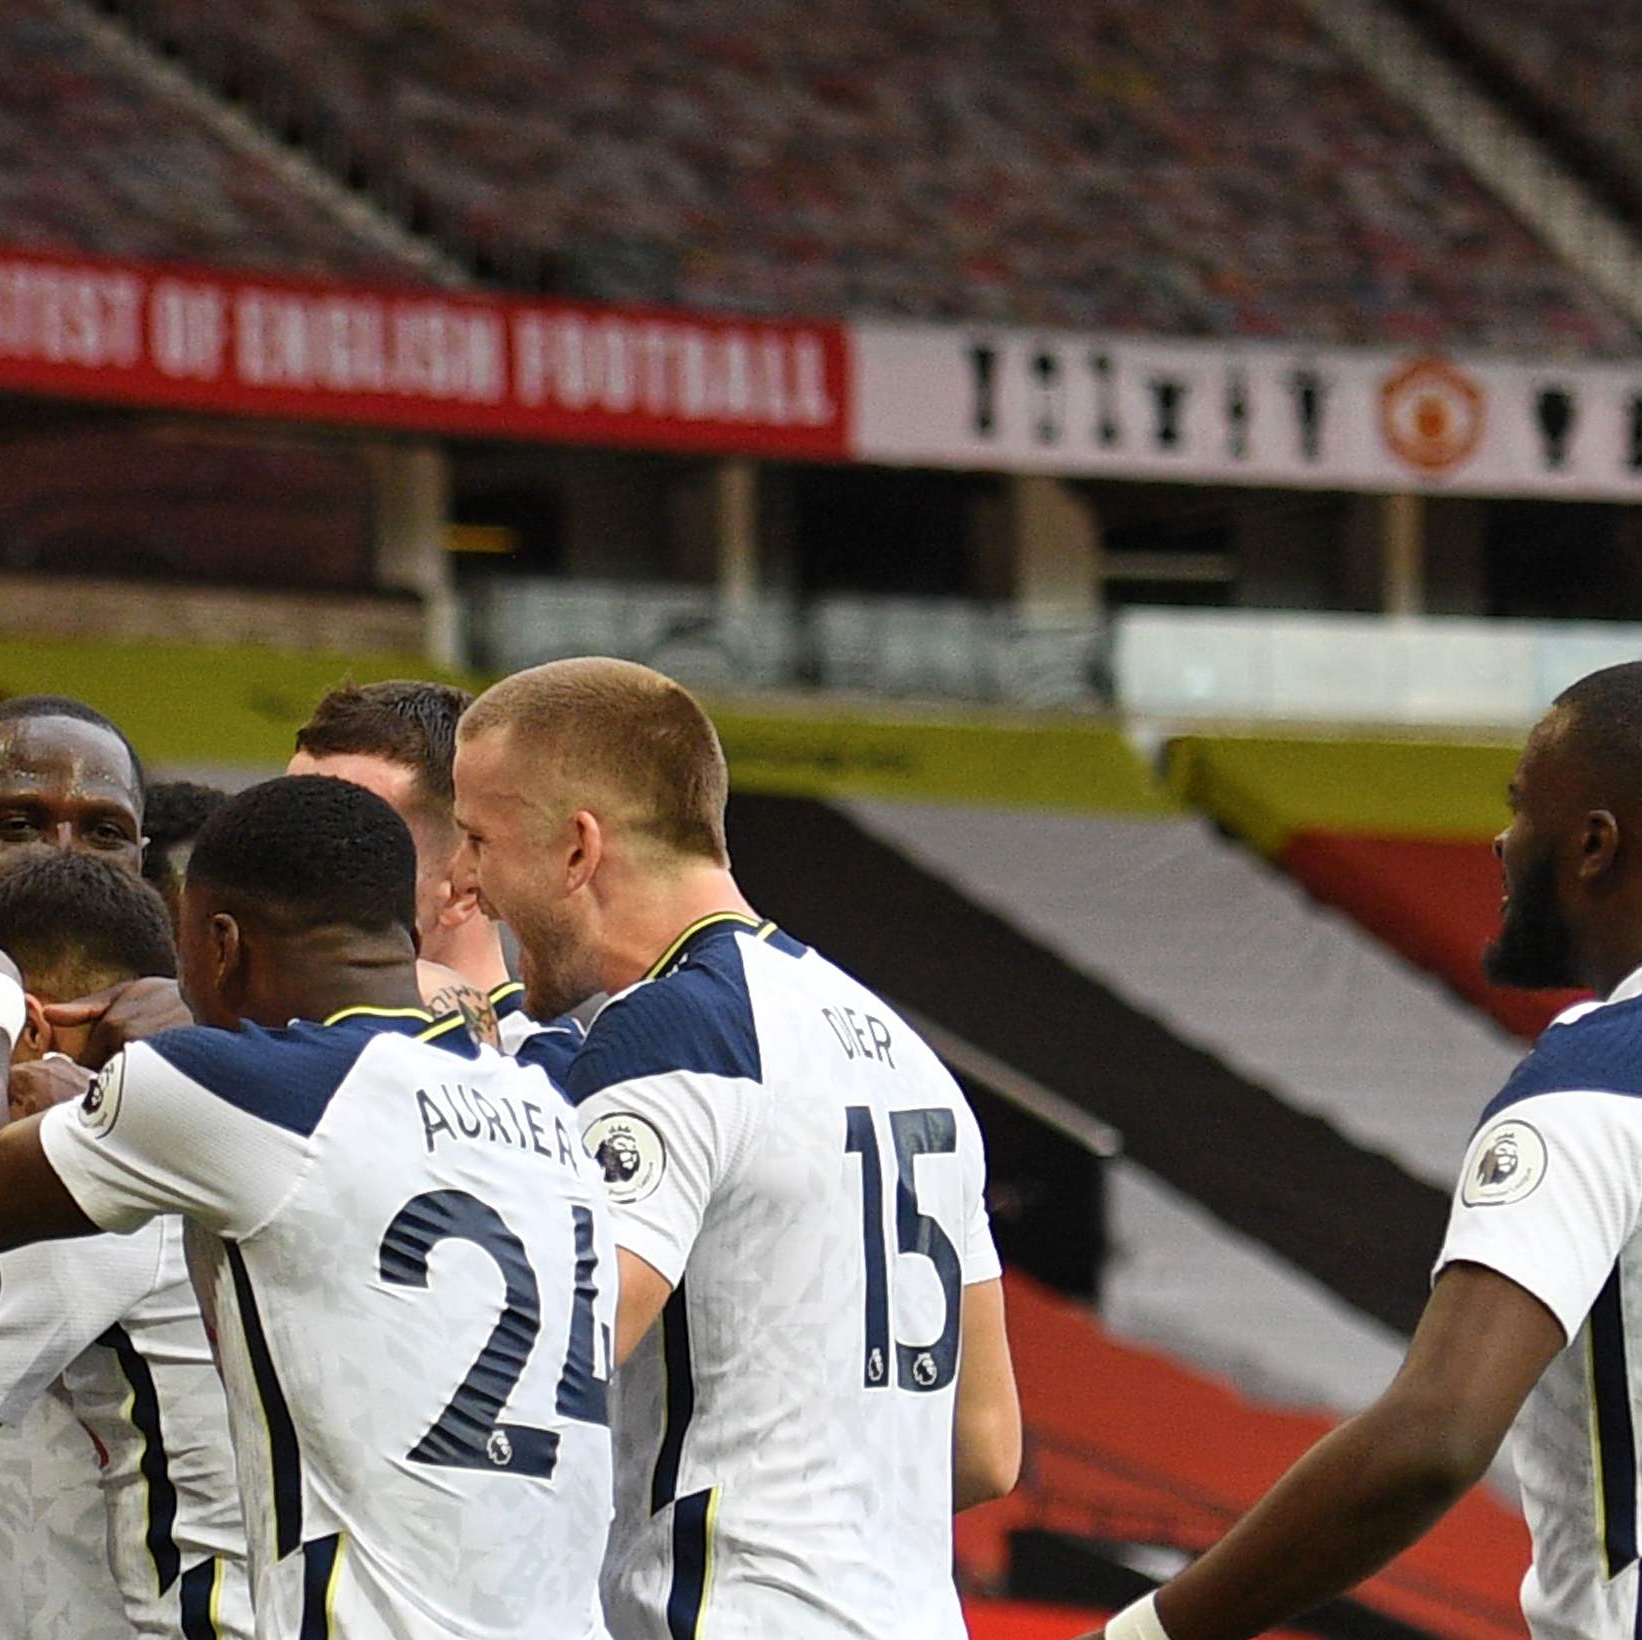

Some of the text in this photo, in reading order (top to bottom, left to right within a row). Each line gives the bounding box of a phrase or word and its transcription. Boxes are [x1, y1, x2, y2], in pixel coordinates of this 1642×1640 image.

[151, 279, 225, 380] OF
[234, 288, 507, 402] ENGLISH
[512, 307, 833, 428] FOOTBALL
[845, 1105, 962, 1393] 15
